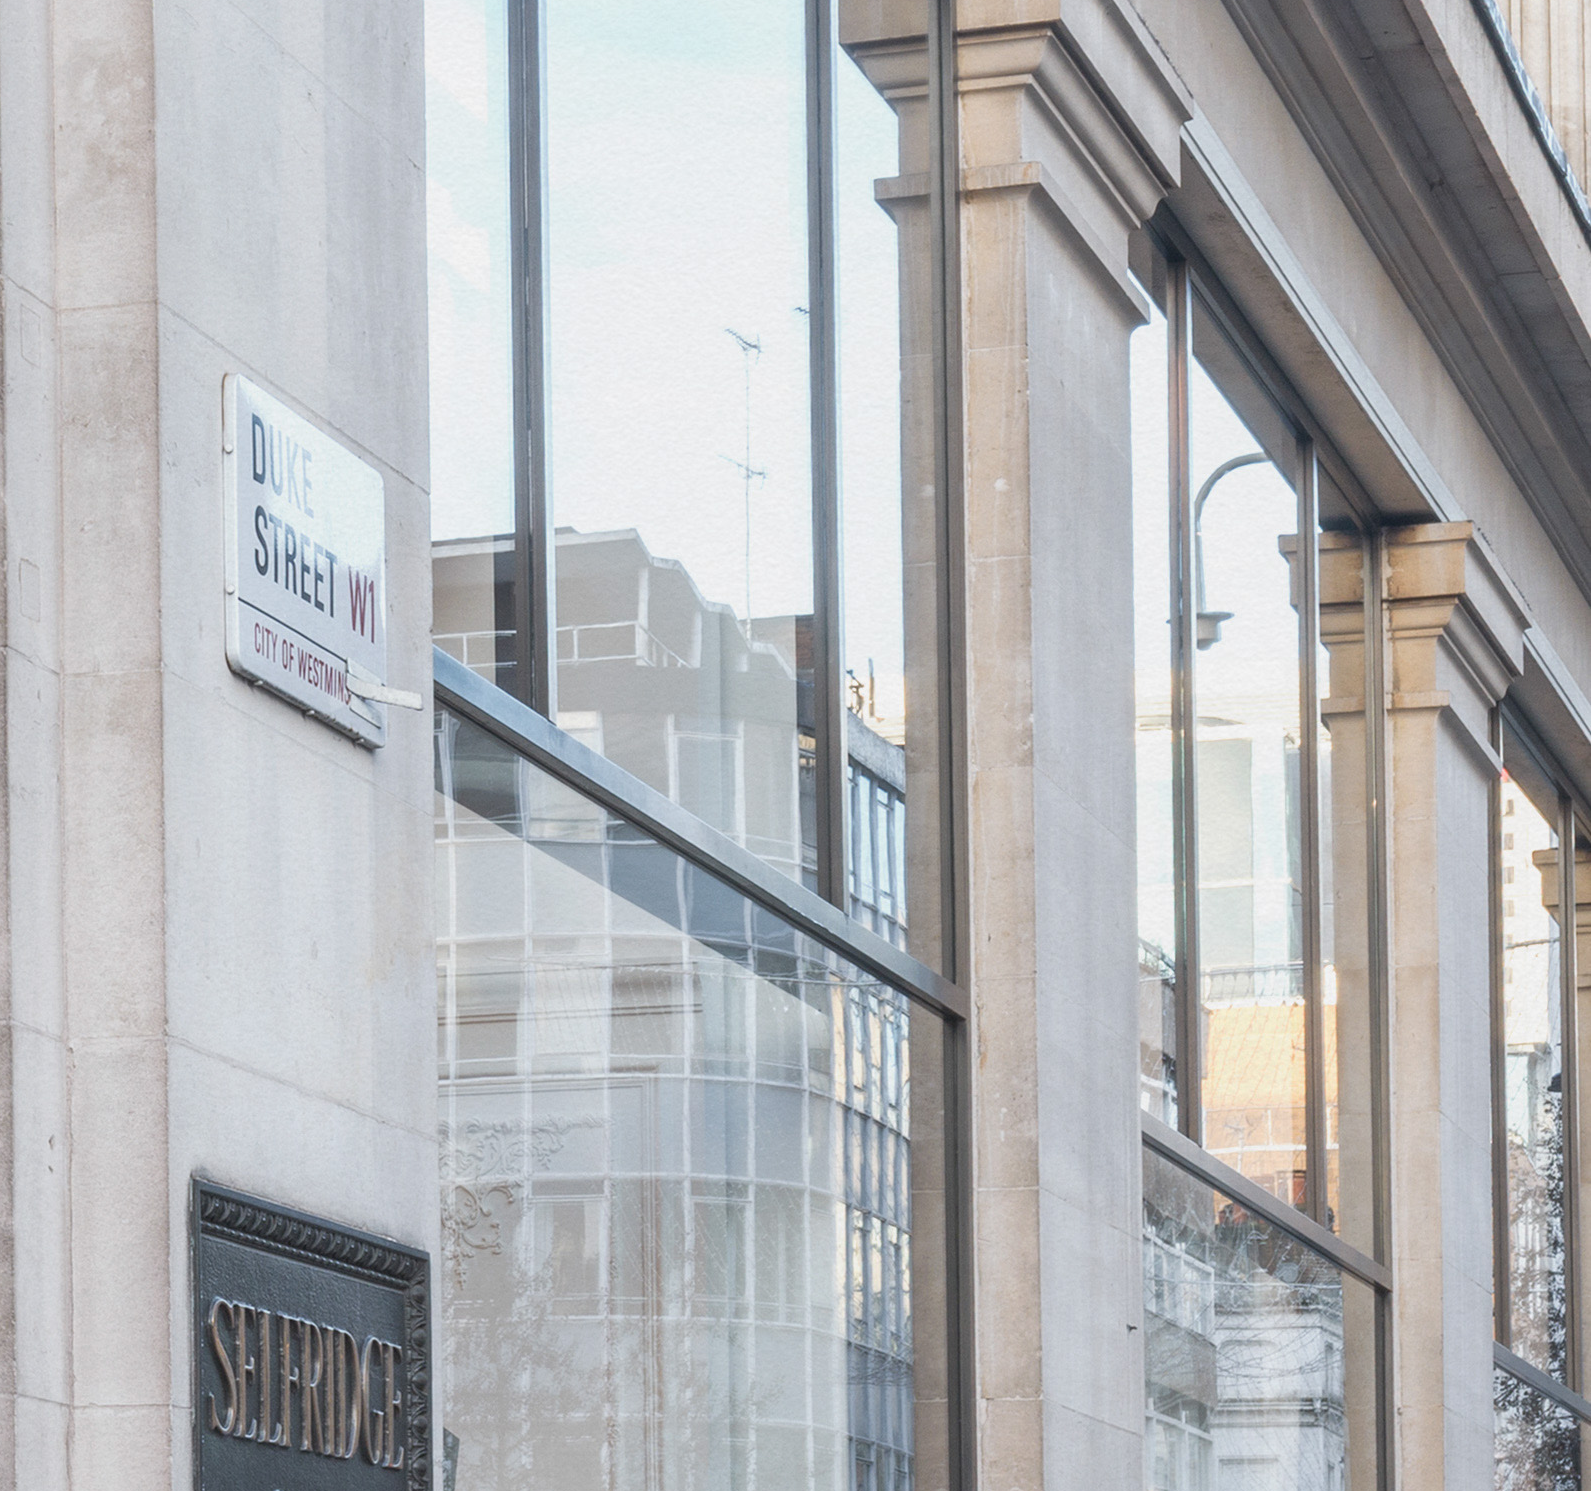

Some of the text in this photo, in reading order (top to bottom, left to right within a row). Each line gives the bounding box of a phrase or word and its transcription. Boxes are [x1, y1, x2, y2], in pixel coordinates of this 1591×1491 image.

[252, 413, 315, 519] DUKE
[254, 504, 376, 644] STREET W1
[254, 622, 278, 664] CITY
[282, 639, 295, 671] OF
[209, 1295, 405, 1470] SELFRIDGE
